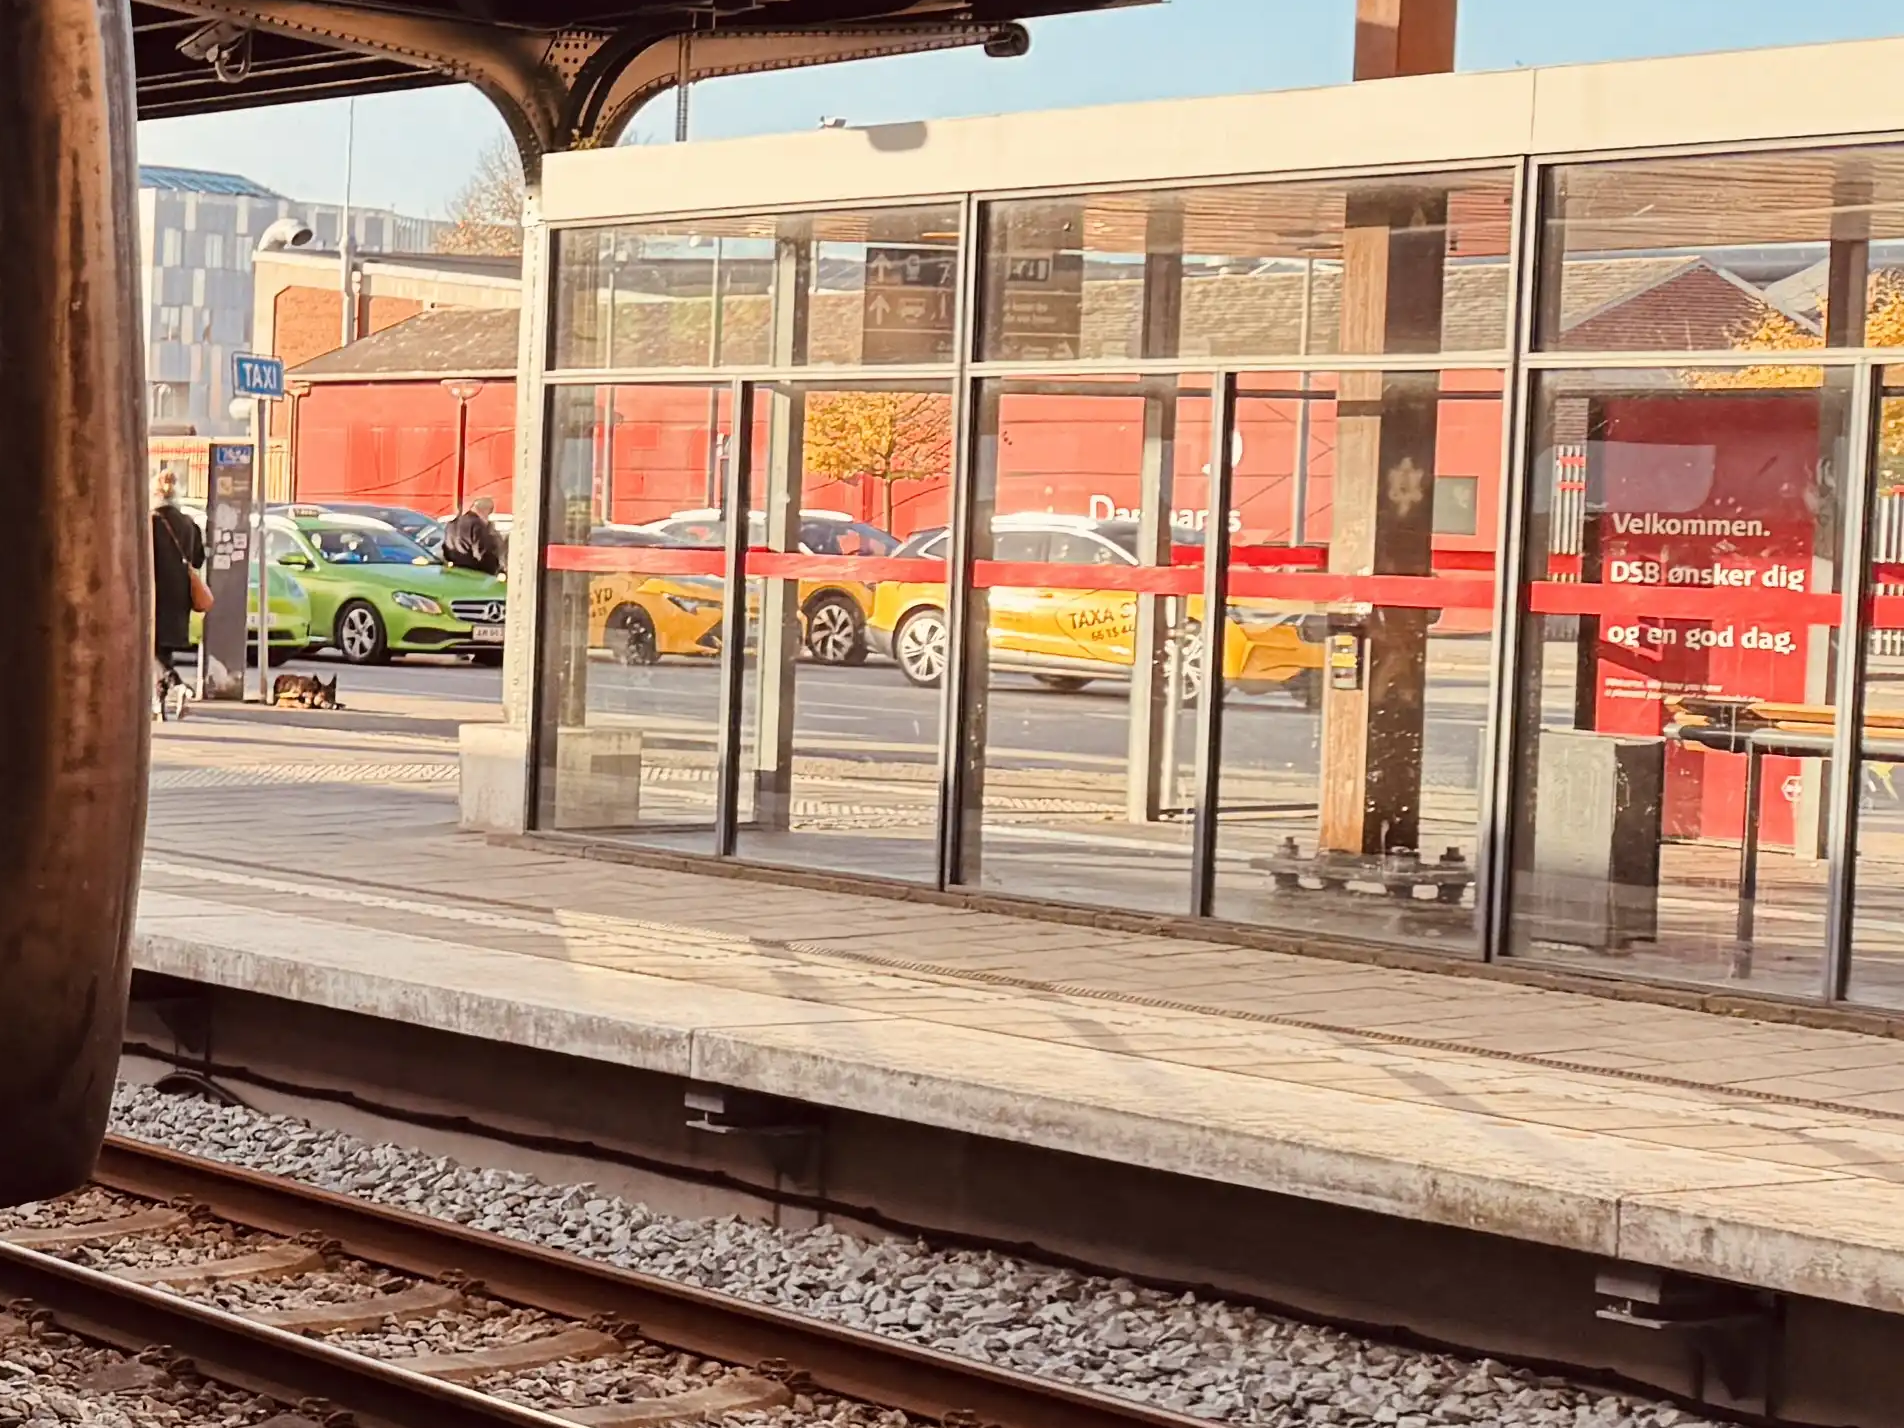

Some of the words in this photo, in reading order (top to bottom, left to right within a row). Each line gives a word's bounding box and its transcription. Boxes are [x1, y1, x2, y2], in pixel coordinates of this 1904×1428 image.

[242, 363, 277, 389] TAXI
[1089, 494, 1242, 533] Daars
[1612, 513, 1771, 537] Velkommen.
[1610, 560, 1660, 583] DSB
[1668, 563, 1756, 587] ønsker
[1762, 564, 1805, 592] dig
[1069, 608, 1114, 630] TAXA
[1607, 625, 1640, 648] og
[1647, 627, 1676, 645] en
[1685, 625, 1734, 650] god
[1741, 626, 1797, 655] dag.
